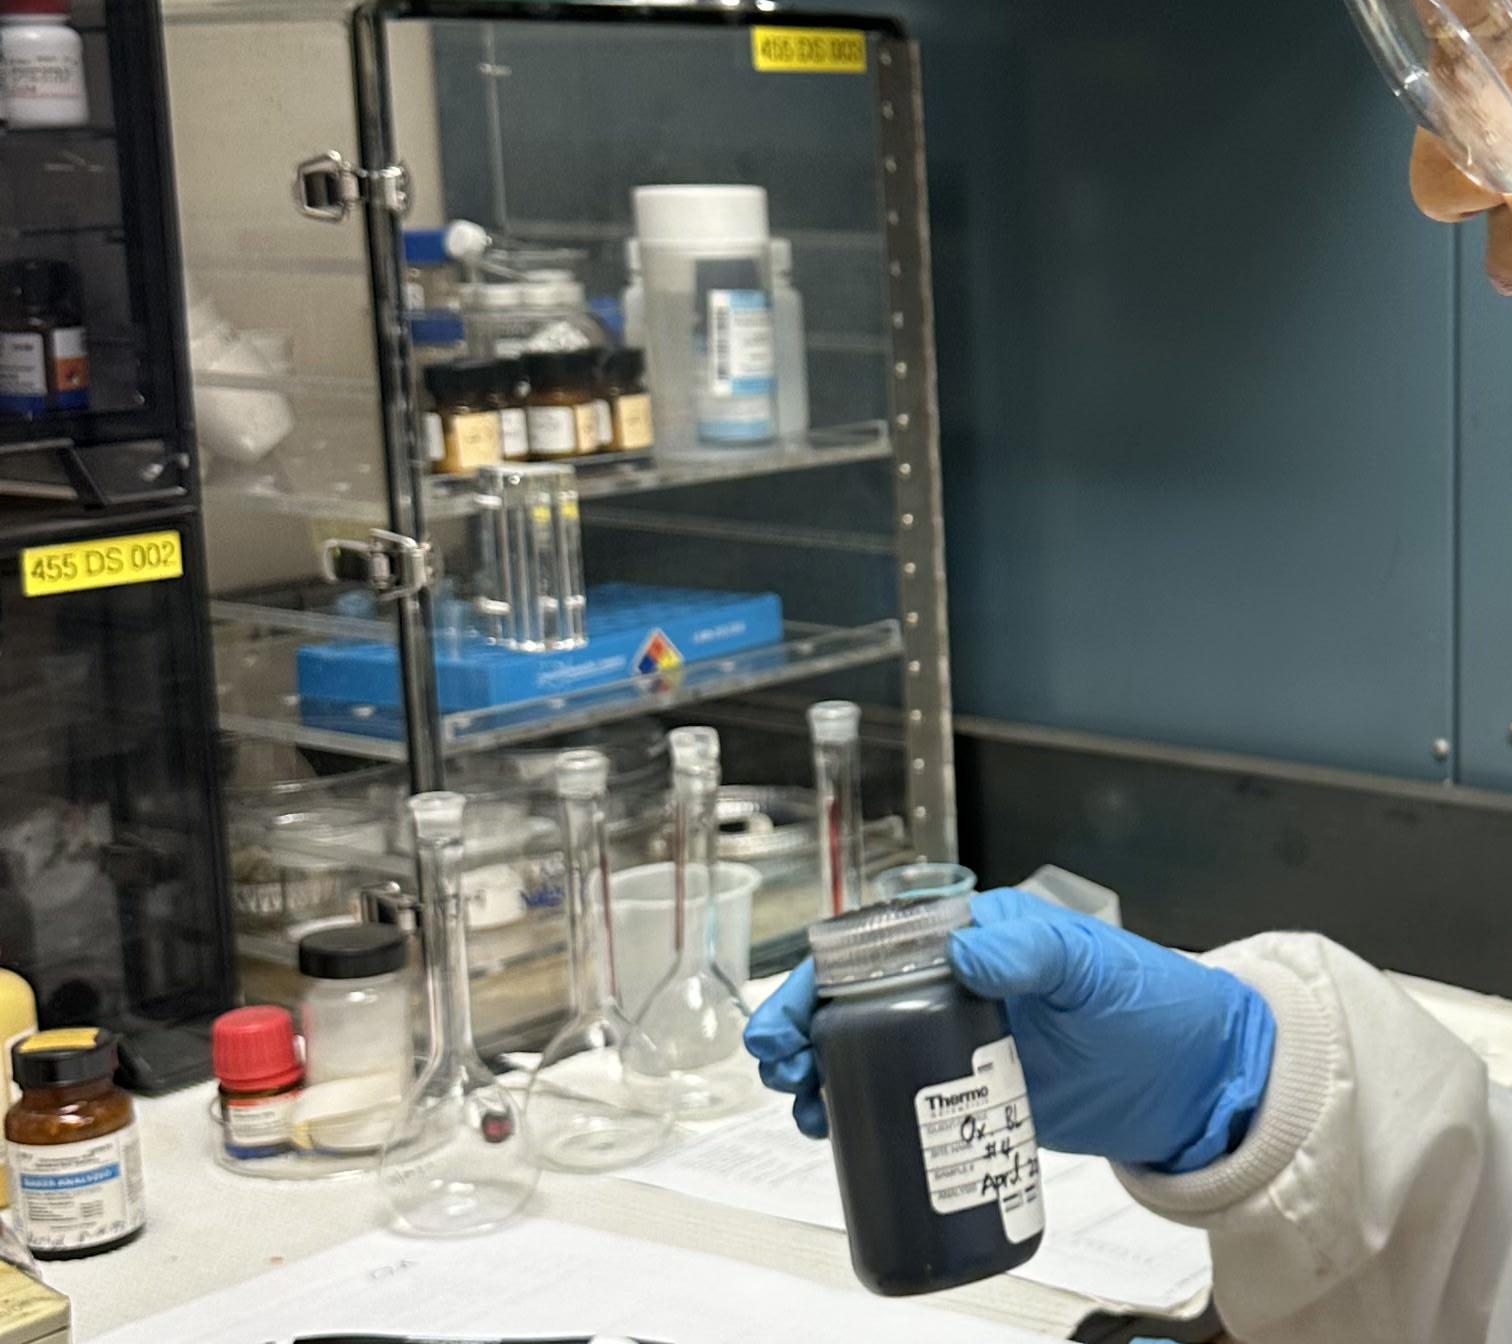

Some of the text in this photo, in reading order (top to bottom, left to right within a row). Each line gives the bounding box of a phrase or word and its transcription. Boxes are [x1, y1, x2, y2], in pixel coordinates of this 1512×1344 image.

[31, 540, 176, 582] 455 DS 002
[924, 1085, 989, 1111] Thermo
